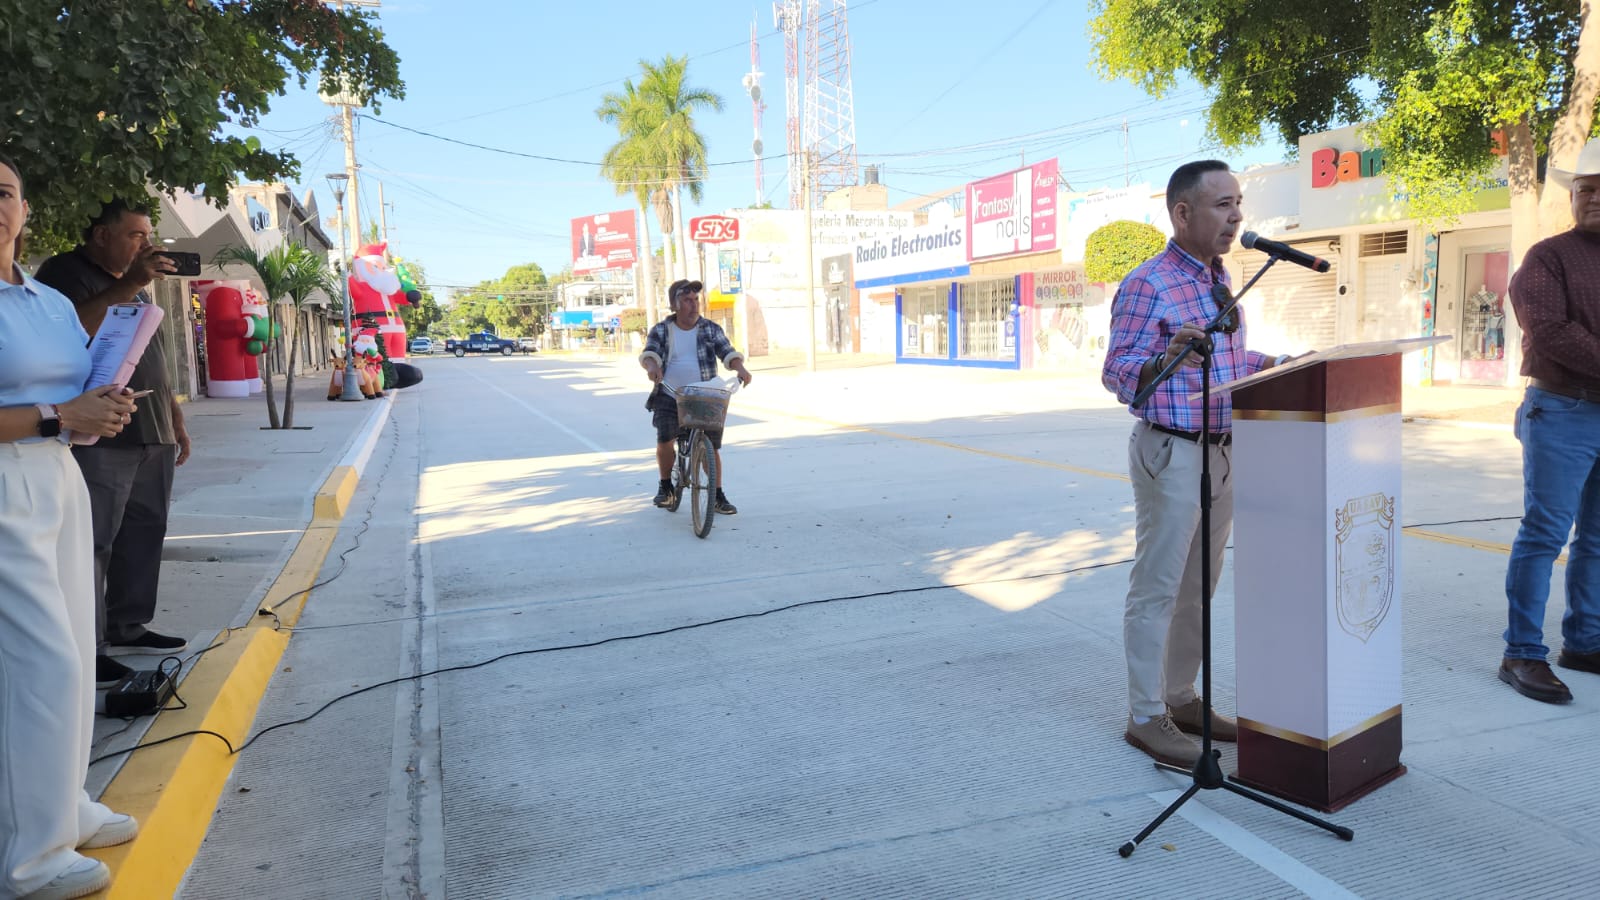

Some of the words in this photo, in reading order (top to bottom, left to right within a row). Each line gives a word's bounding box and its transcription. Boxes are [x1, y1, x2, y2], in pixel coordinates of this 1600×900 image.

[975, 190, 1015, 219] Fantasy
[856, 240, 887, 263] Radio
[891, 224, 962, 257] Electronics
[1042, 270, 1077, 284] MIRROR
